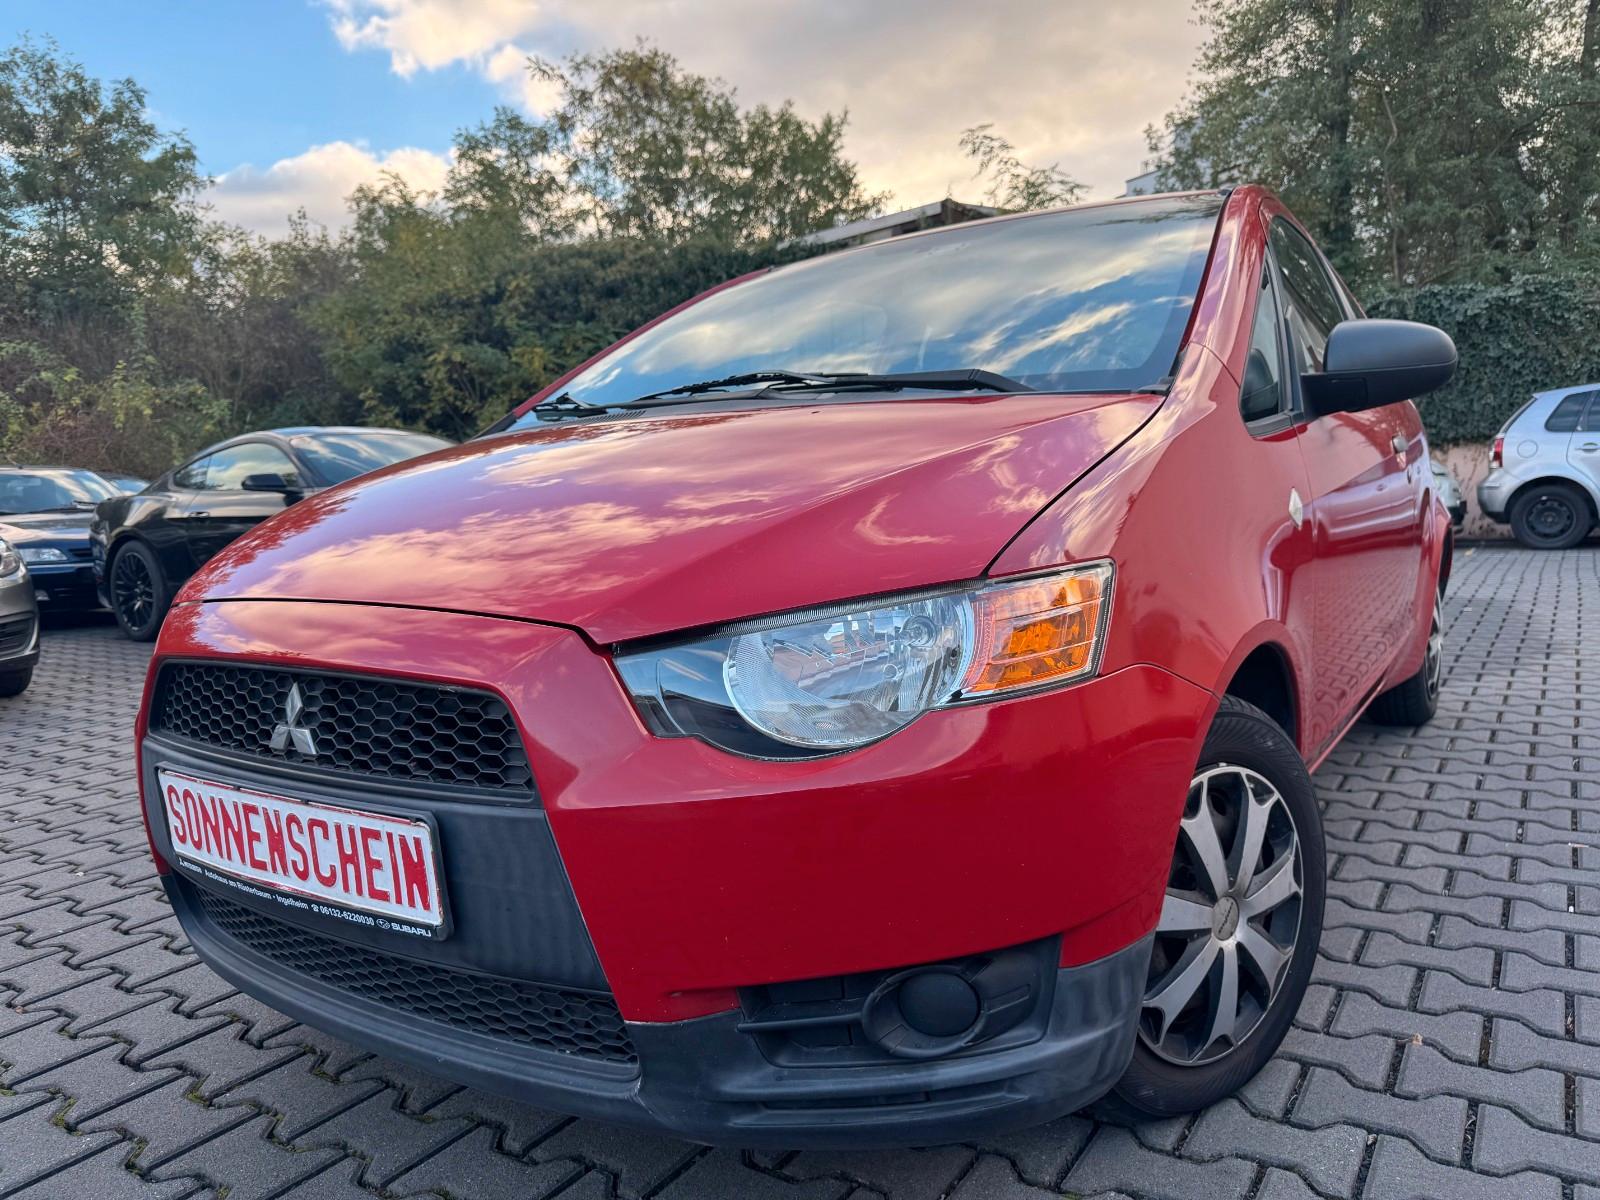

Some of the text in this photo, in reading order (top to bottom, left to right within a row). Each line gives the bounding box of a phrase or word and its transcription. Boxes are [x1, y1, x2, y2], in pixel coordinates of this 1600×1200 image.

[166, 784, 431, 911] SONNENSCHEIN
[275, 893, 309, 910] Ingelheim
[390, 922, 432, 937] SUBARU
